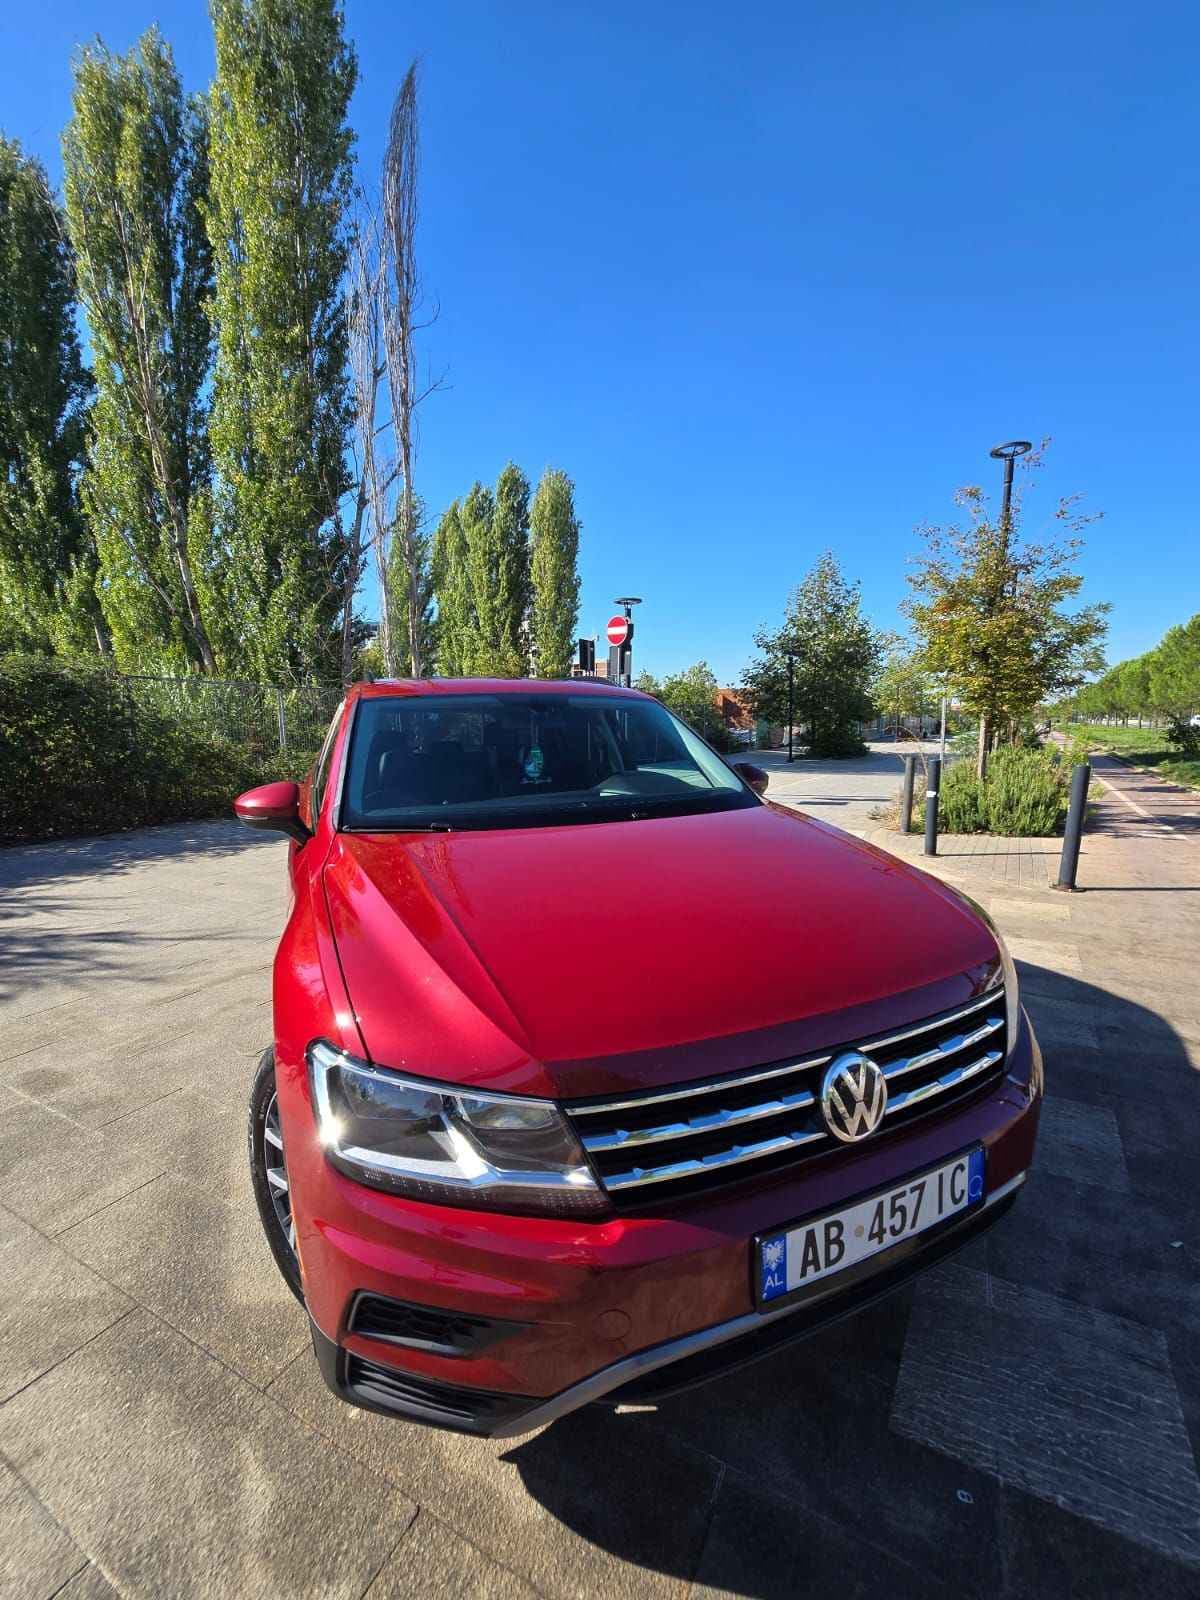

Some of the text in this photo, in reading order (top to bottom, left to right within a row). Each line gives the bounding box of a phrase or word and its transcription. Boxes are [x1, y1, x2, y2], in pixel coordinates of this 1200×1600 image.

[825, 1057, 885, 1139] VW
[800, 1163, 966, 1279] AB 457 IC
[764, 1272, 784, 1290] AL
